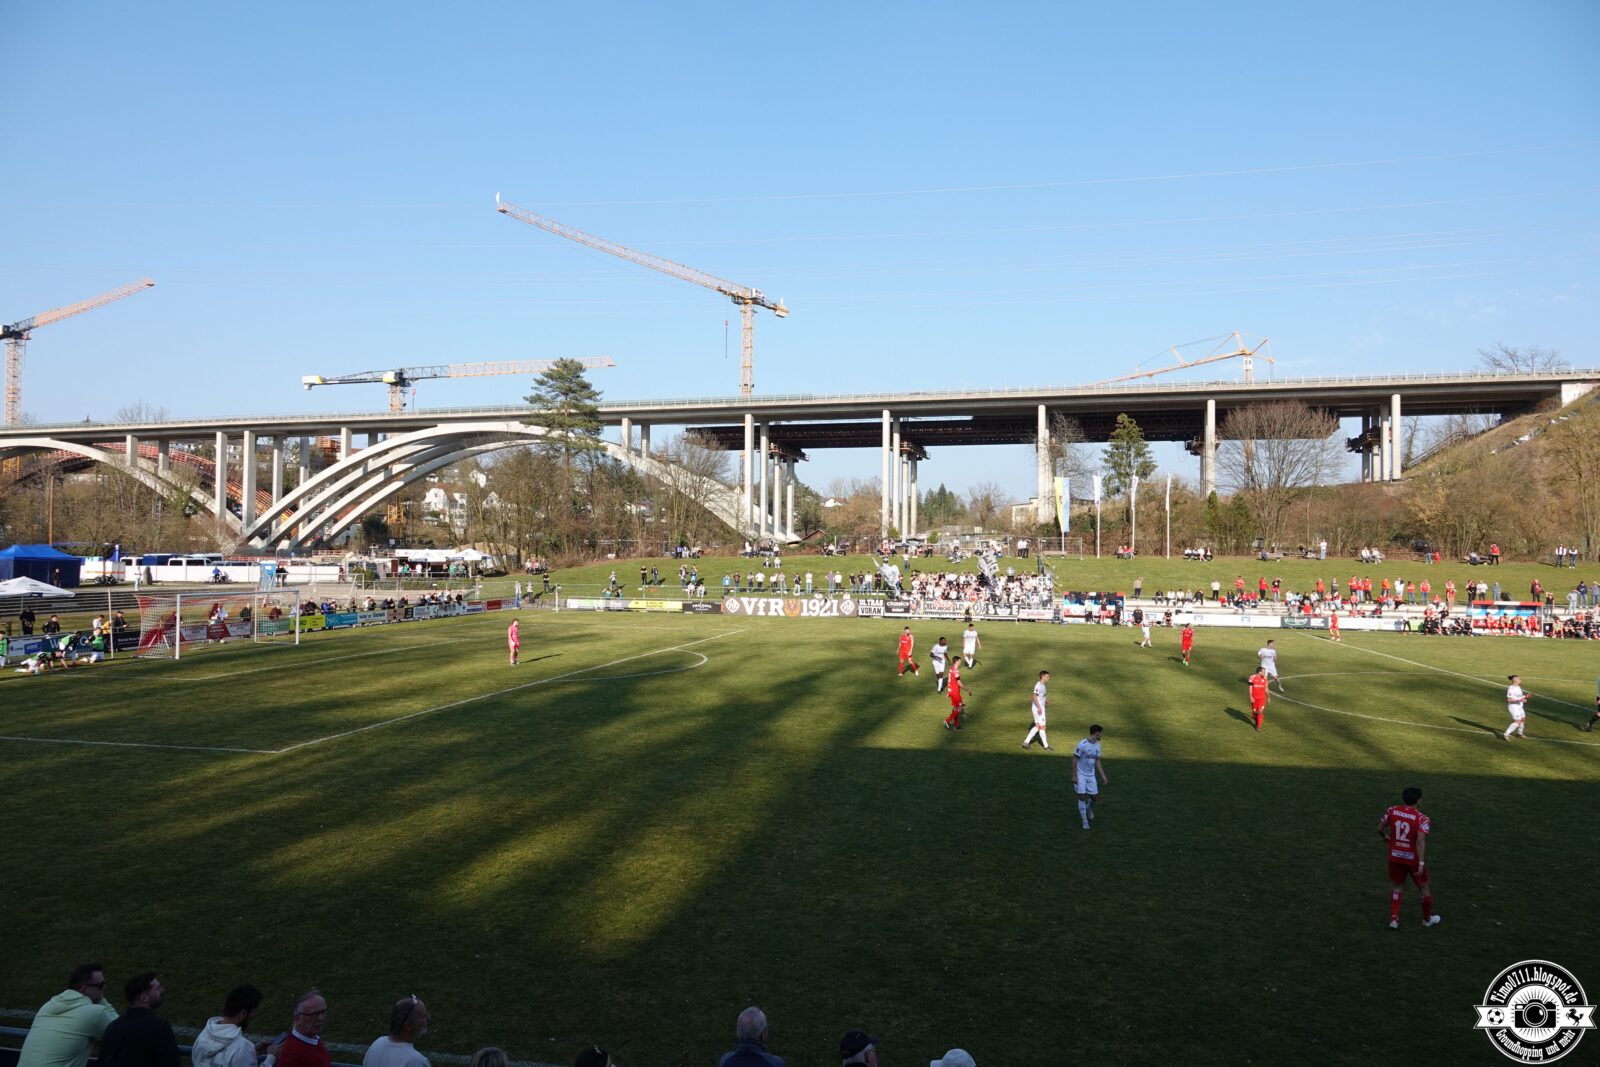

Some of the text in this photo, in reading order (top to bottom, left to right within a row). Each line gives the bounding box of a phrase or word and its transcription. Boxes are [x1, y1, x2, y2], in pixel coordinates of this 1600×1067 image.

[740, 597, 786, 616] VfR
[800, 598, 840, 616] 1921
[1395, 820, 1410, 841] 12
